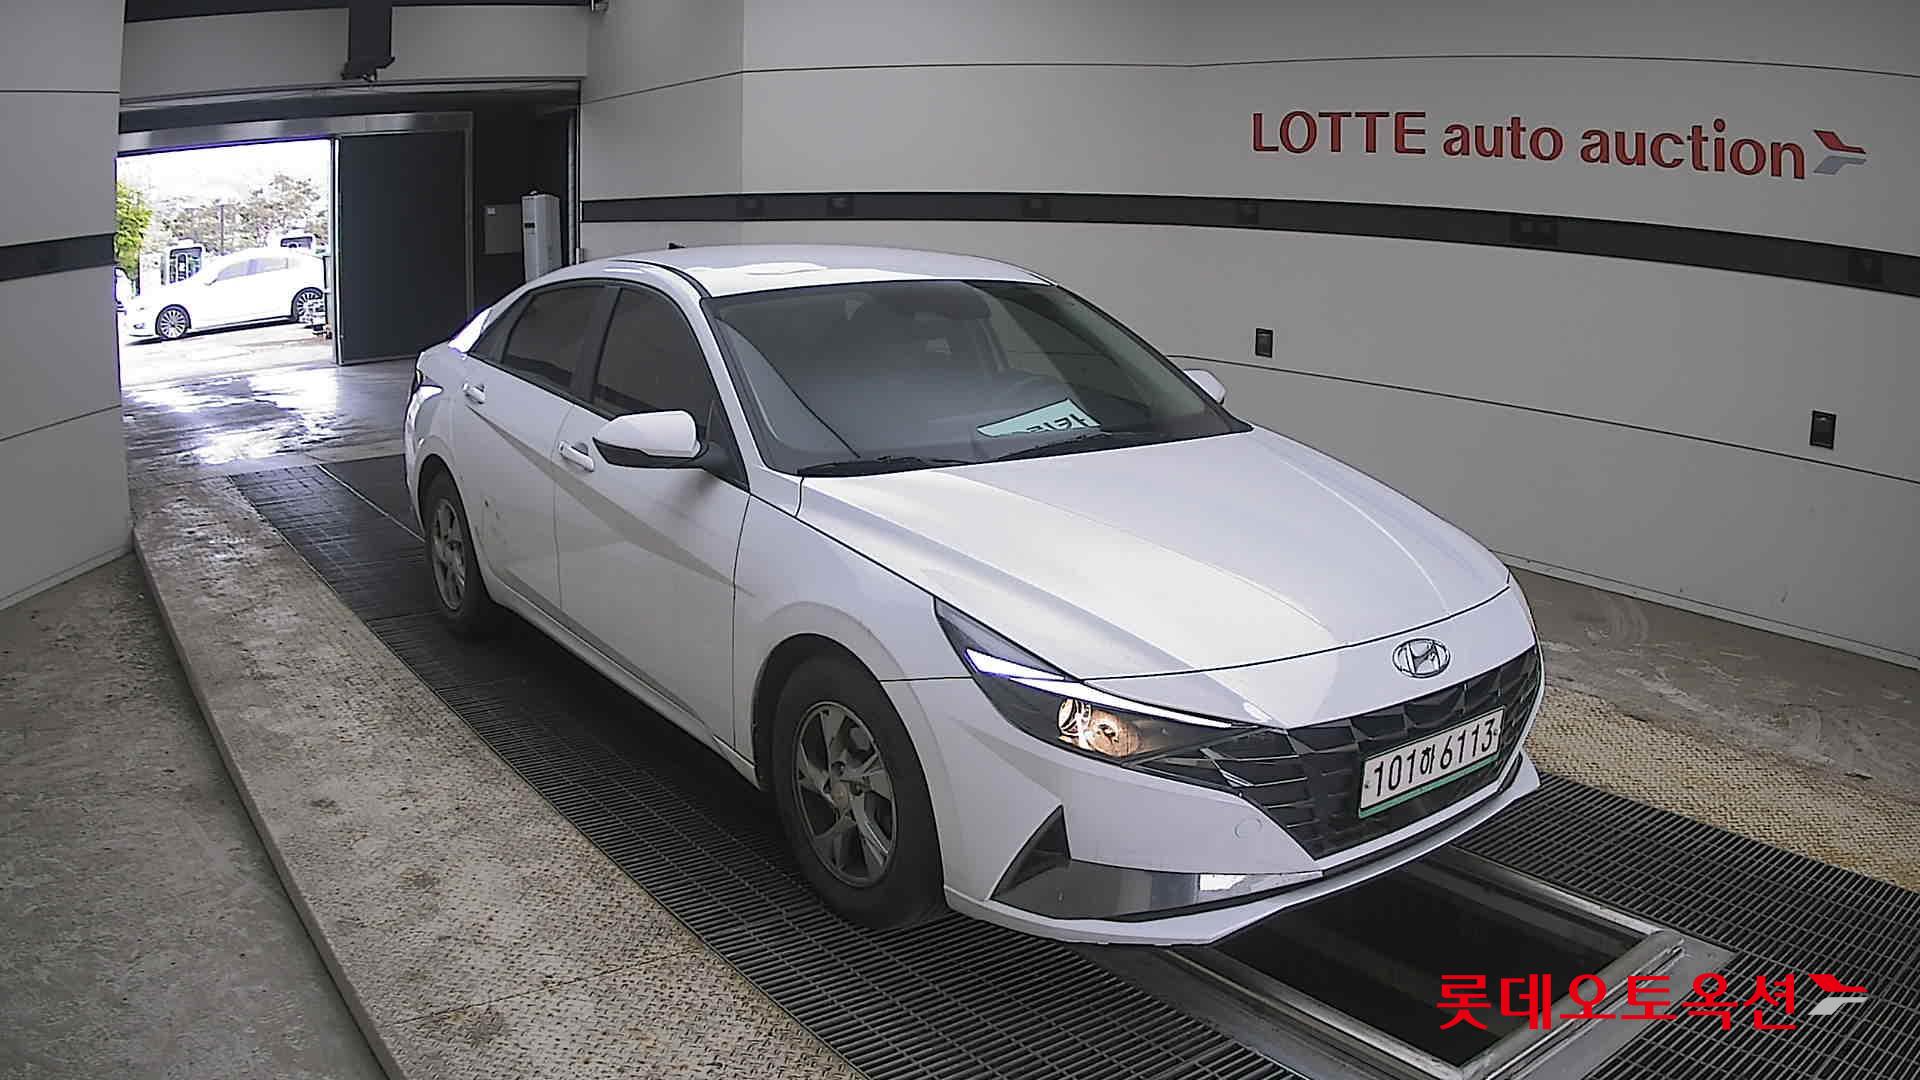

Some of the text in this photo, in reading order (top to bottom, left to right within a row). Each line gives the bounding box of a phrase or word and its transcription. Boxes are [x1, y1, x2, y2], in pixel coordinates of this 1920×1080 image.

[1252, 111, 1807, 180] LOTTE auto auction
